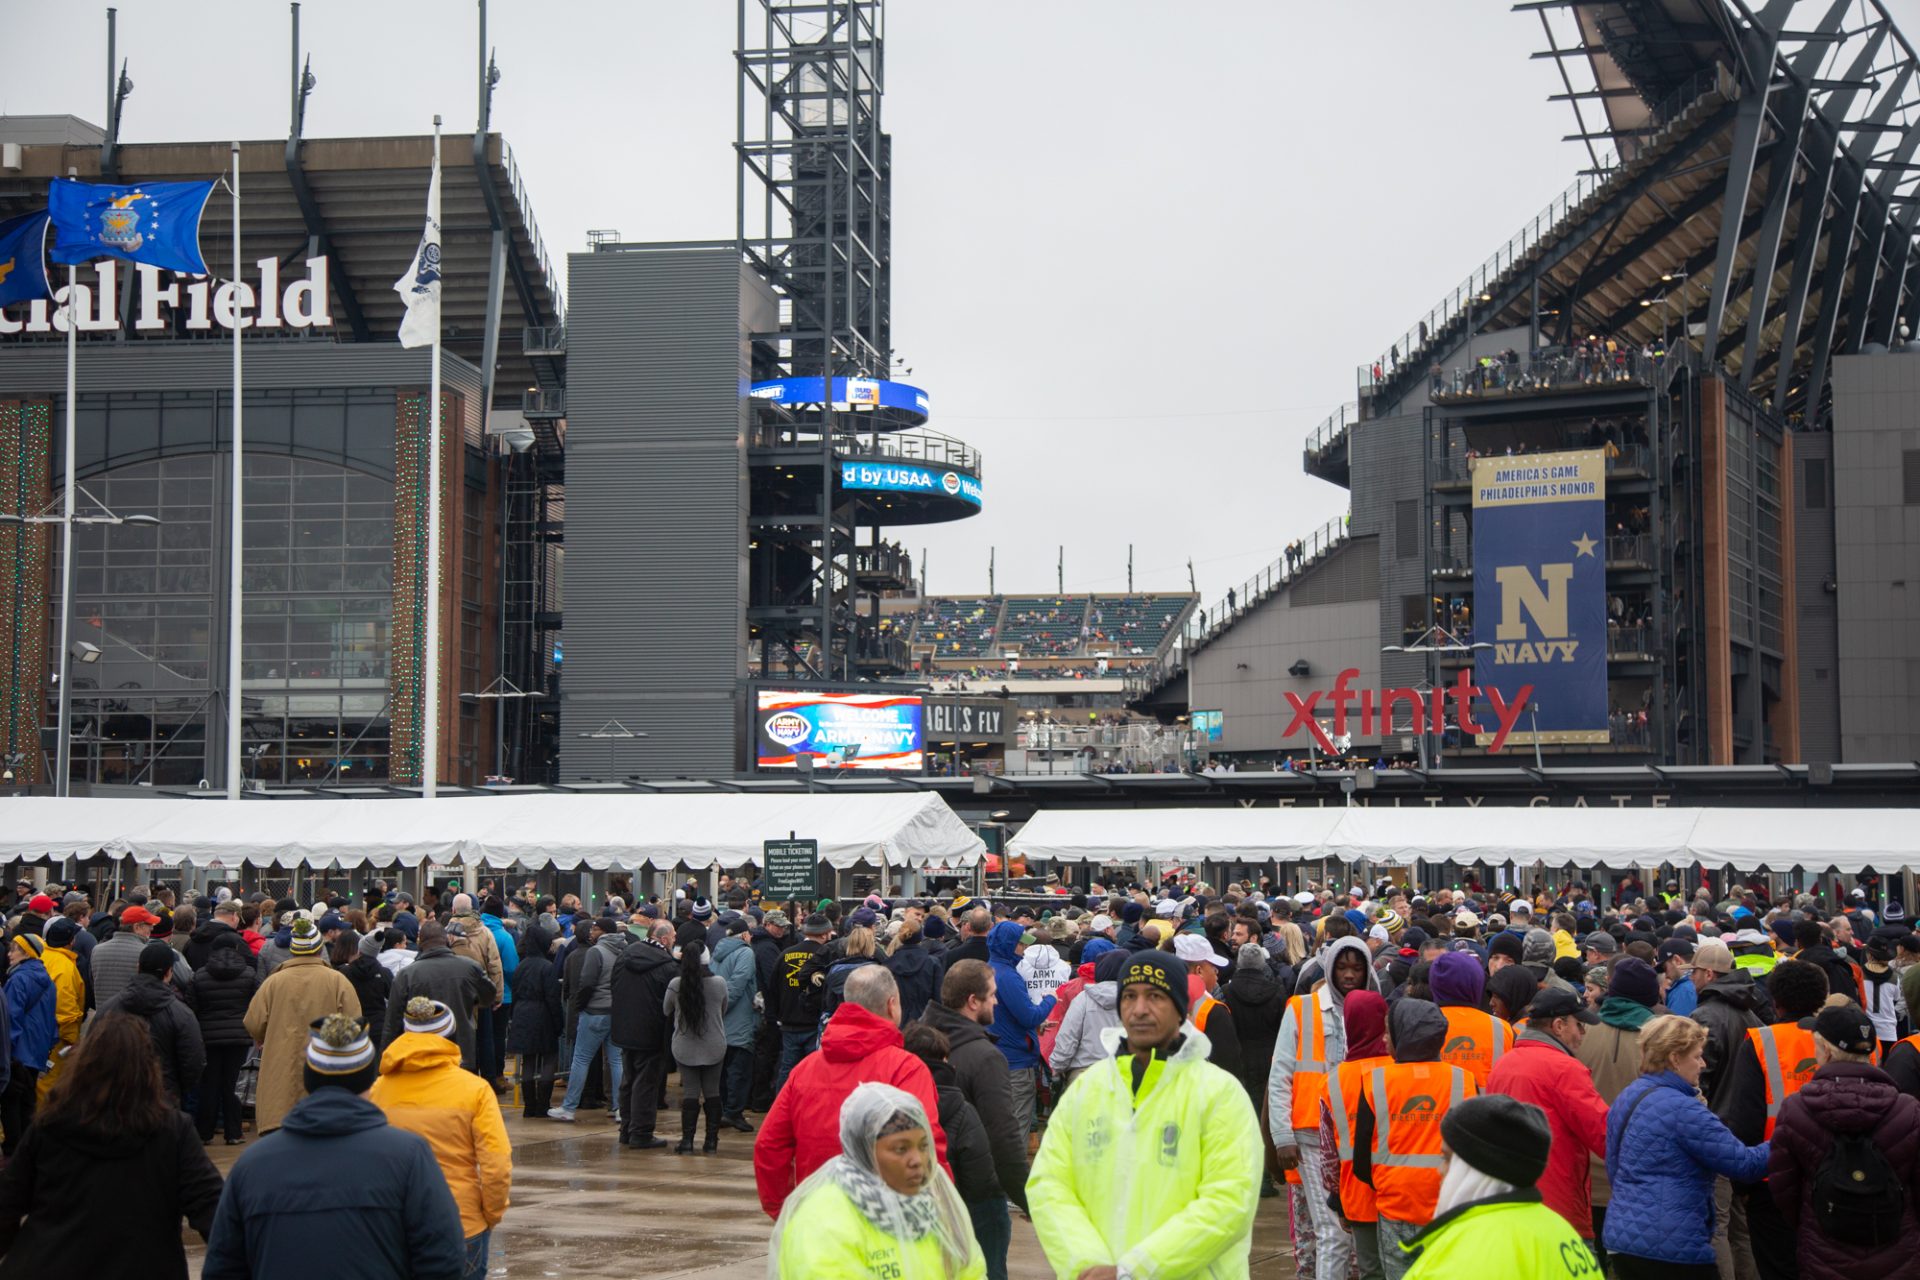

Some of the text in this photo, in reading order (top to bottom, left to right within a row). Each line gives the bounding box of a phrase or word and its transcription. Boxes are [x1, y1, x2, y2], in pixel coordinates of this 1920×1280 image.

[135, 255, 332, 330] Field
[861, 468, 882, 485] by
[887, 469, 932, 487] USAA
[1551, 465, 1579, 479] GAME
[1480, 482, 1595, 501] PHILADELPHIA'S HONOR
[1495, 563, 1574, 640] N
[1494, 640, 1579, 664] NAVY
[833, 709, 899, 723] WELCOME
[1282, 668, 1535, 755] xfinity
[776, 717, 800, 726] ARMY
[978, 711, 1000, 733] FLY
[777, 728, 800, 737] NAVY
[815, 729, 916, 745] ARMY NAVY
[788, 847, 813, 855] TICKETING
[784, 952, 808, 962] QUEEN'S
[1033, 970, 1056, 979] ARMY
[1130, 964, 1166, 980] CSC
[1025, 979, 1066, 989] EST POIN
[1123, 975, 1171, 990] EVENT STAFF
[1560, 1239, 1599, 1278] CSC
